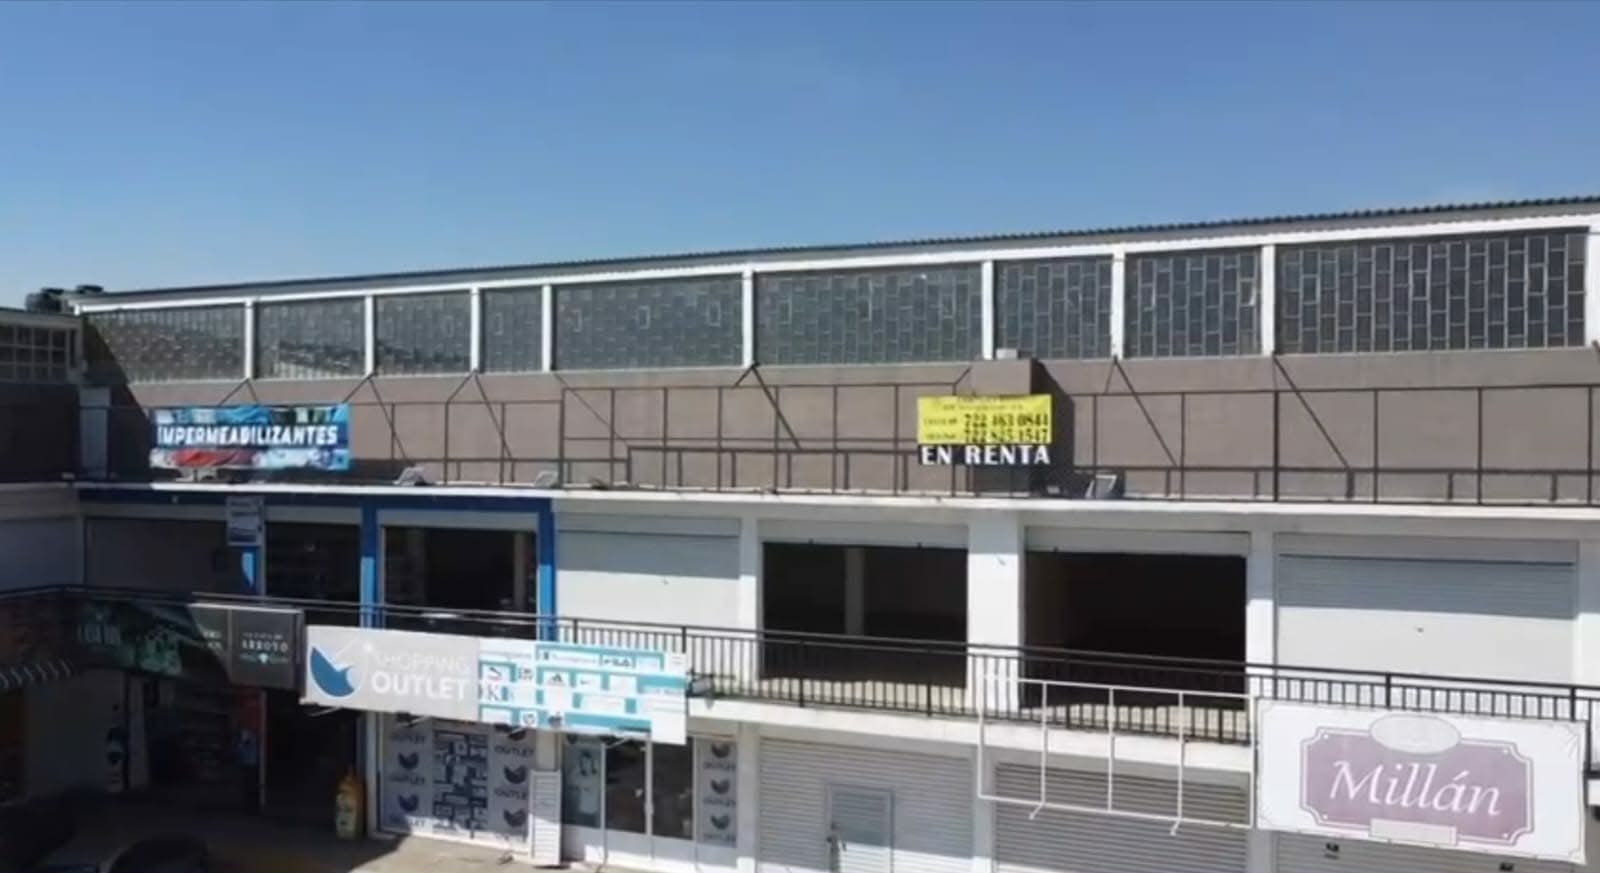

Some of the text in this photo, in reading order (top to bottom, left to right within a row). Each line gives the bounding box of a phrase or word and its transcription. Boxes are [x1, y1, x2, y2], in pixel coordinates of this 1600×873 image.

[157, 425, 339, 445] IMPERMEABILIZANTES
[921, 444, 1051, 465] EN RENTA
[374, 650, 470, 675] SHOPPING
[371, 670, 470, 701] OUTLET
[1329, 760, 1500, 816] Millán
